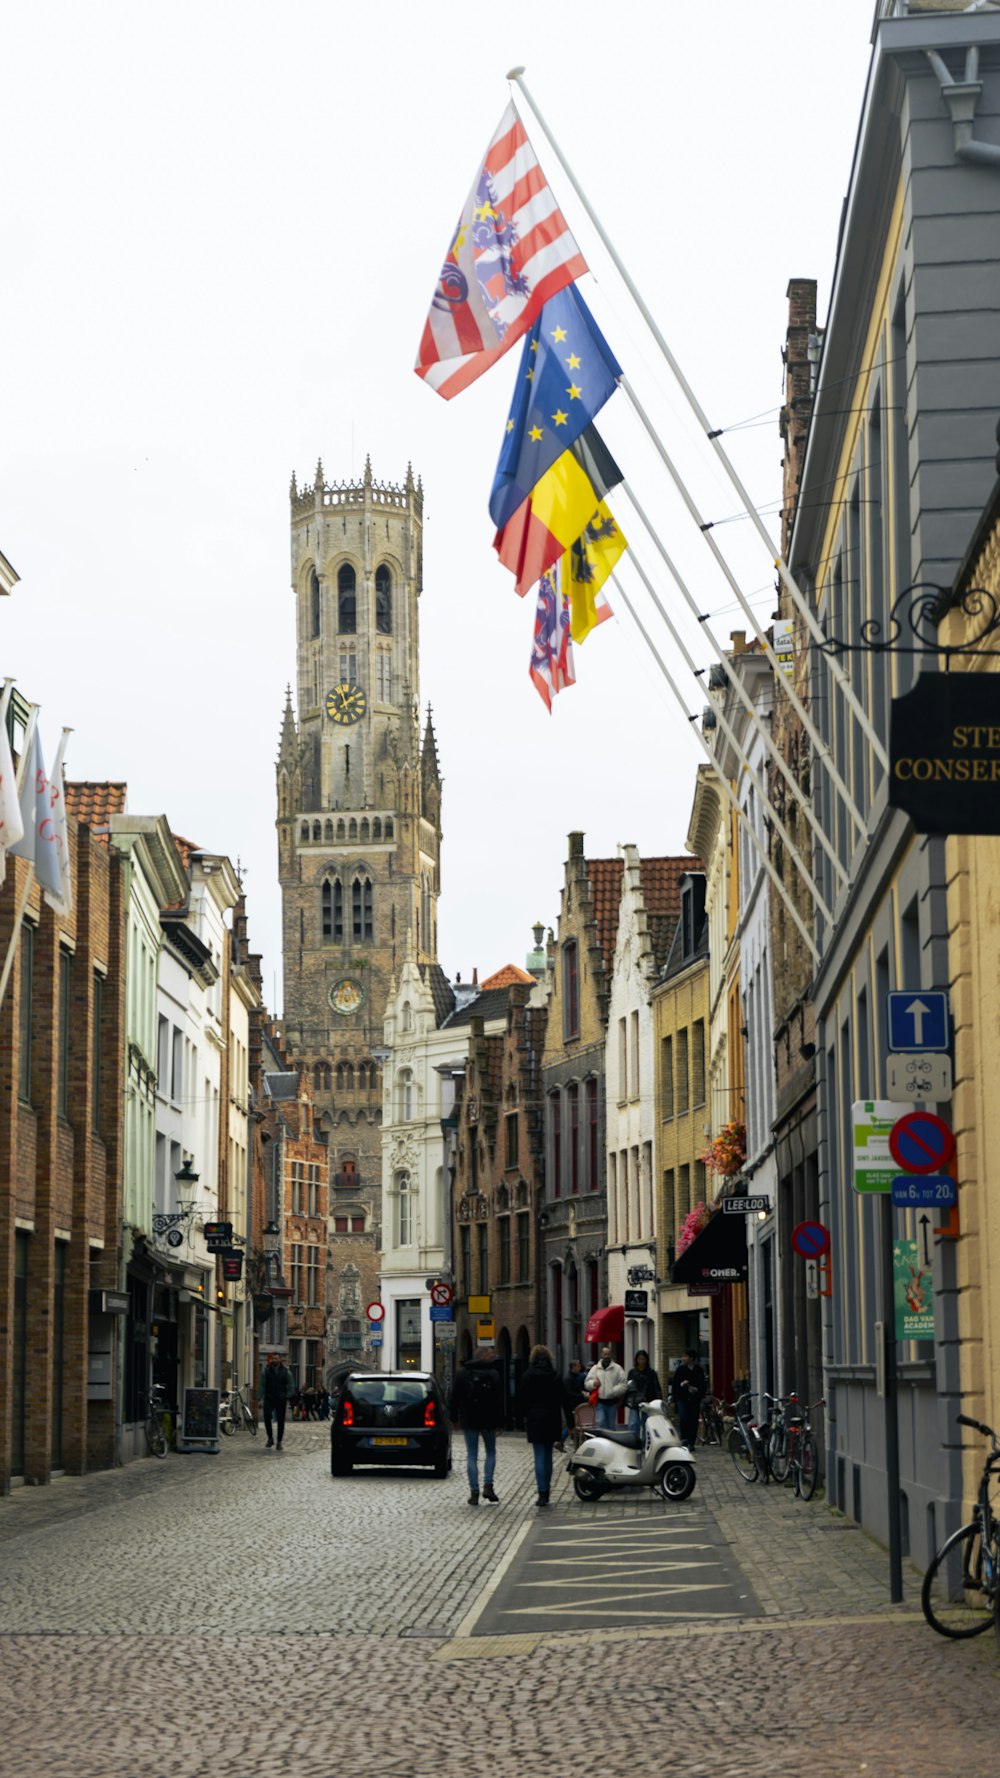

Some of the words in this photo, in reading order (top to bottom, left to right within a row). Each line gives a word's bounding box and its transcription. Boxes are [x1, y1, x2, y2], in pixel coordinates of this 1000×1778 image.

[952, 726, 1000, 749] STE
[894, 1190, 907, 1198] VAN
[922, 1190, 934, 1198] TOT
